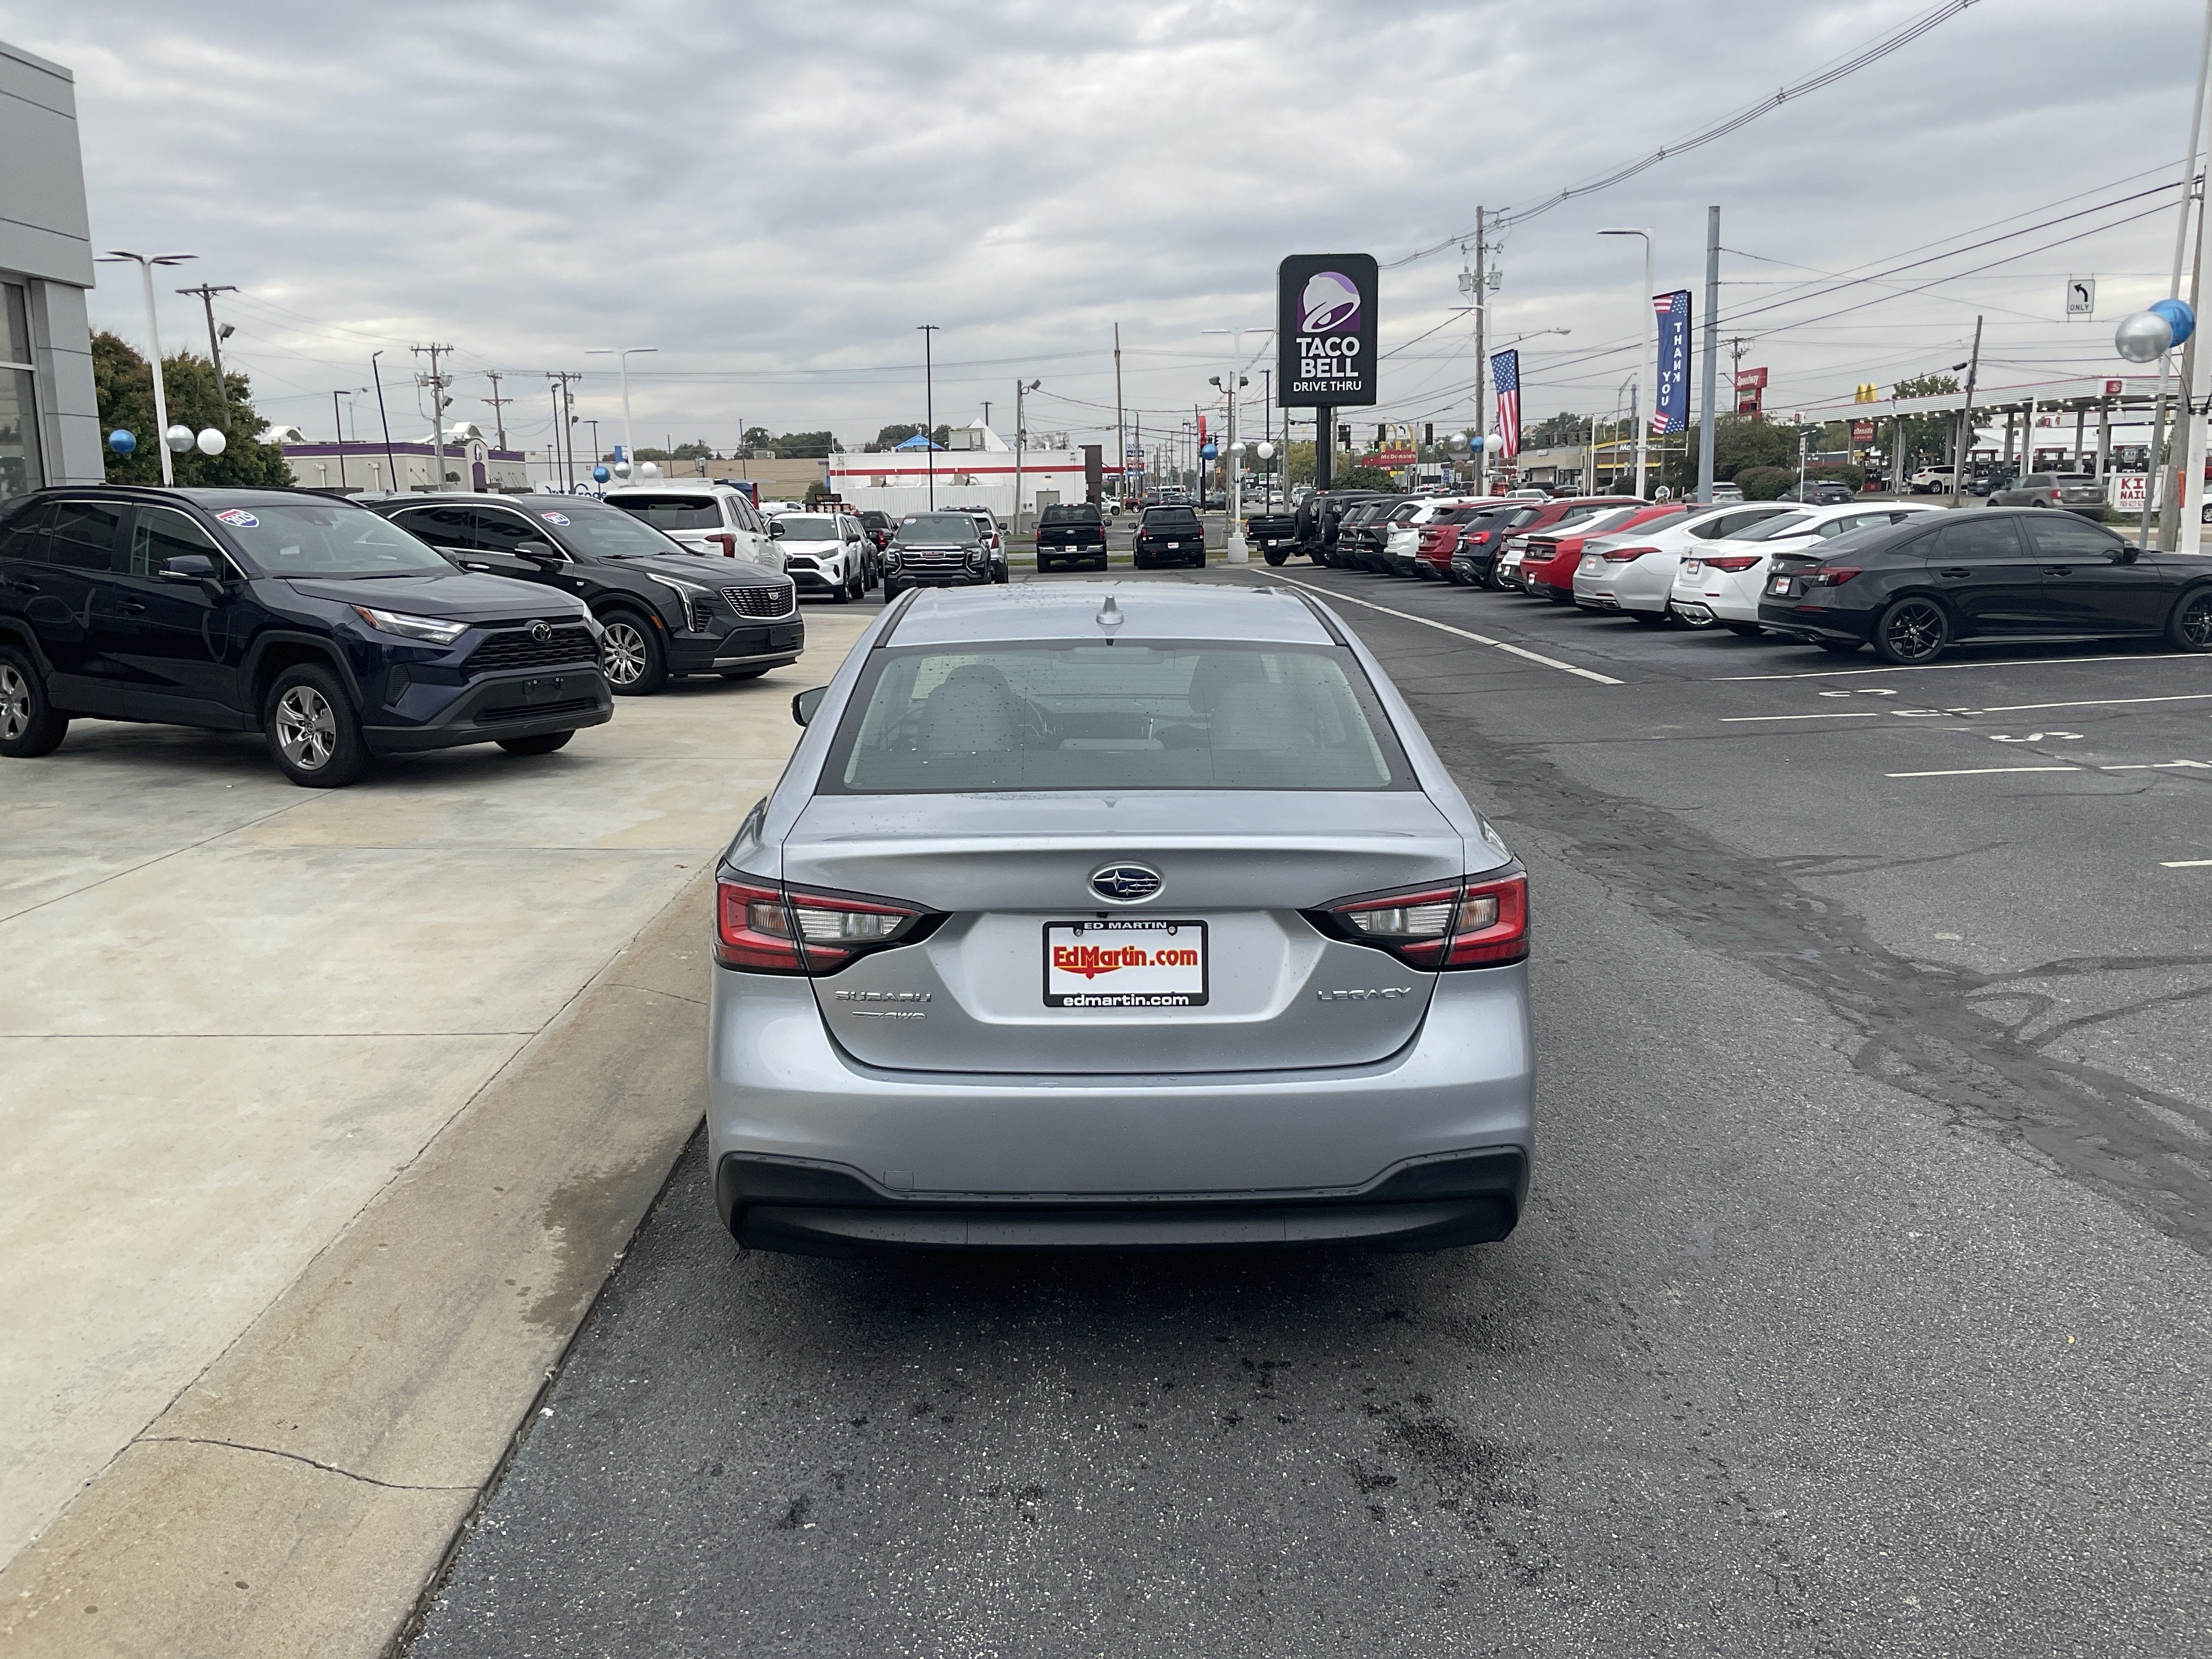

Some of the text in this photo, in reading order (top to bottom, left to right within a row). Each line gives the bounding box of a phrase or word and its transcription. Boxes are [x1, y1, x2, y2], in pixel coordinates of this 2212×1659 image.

[1296, 336, 1360, 357] TACO
[1301, 358, 1359, 378] BELL
[1293, 381, 1362, 392] DRIVE THRU
[2121, 478, 2148, 489] KI
[2120, 491, 2146, 499] NAIL
[1053, 945, 1198, 967] EdMartin.com
[835, 991, 931, 1002] SUBARU
[1063, 994, 1189, 1006] edmartin.com
[1318, 988, 1412, 1000] LEGACY
